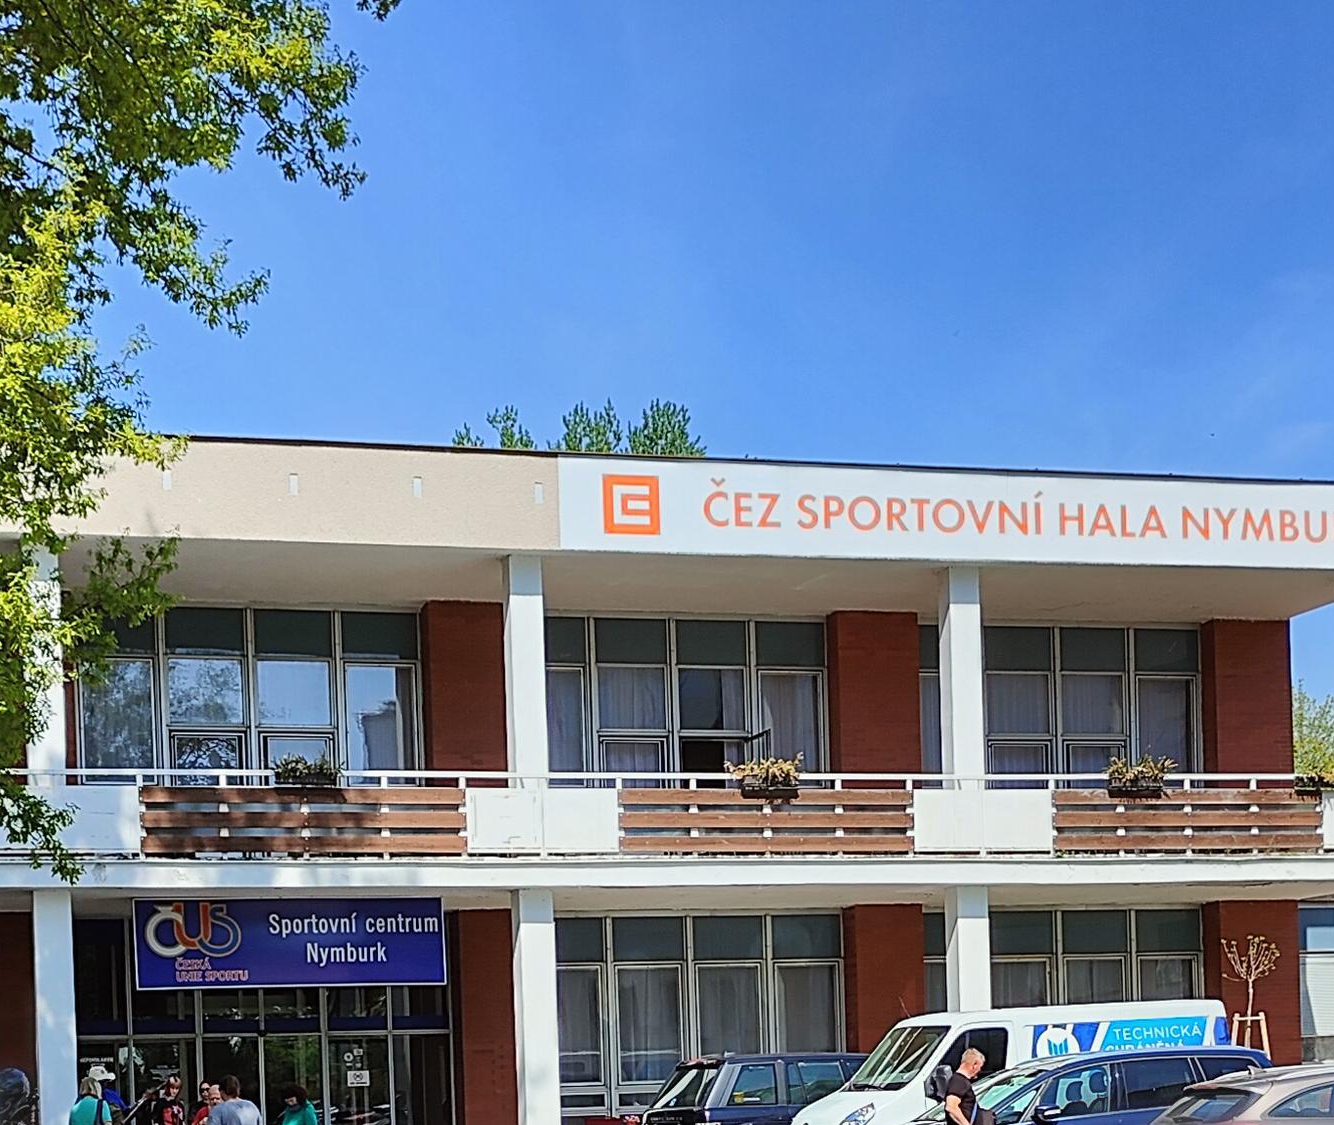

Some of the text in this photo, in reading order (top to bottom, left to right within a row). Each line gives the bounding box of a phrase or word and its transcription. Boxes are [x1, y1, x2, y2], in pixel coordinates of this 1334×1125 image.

[703, 477, 782, 528] ČEZ
[797, 491, 1044, 536] SPORTOVNÍ
[1058, 502, 1168, 539] HALA
[269, 912, 439, 938] Sportovní centrum
[306, 942, 388, 967] Nymburk
[175, 970, 249, 982] UNIE SPORTU
[1113, 1022, 1203, 1041] TECHNICKÁ
